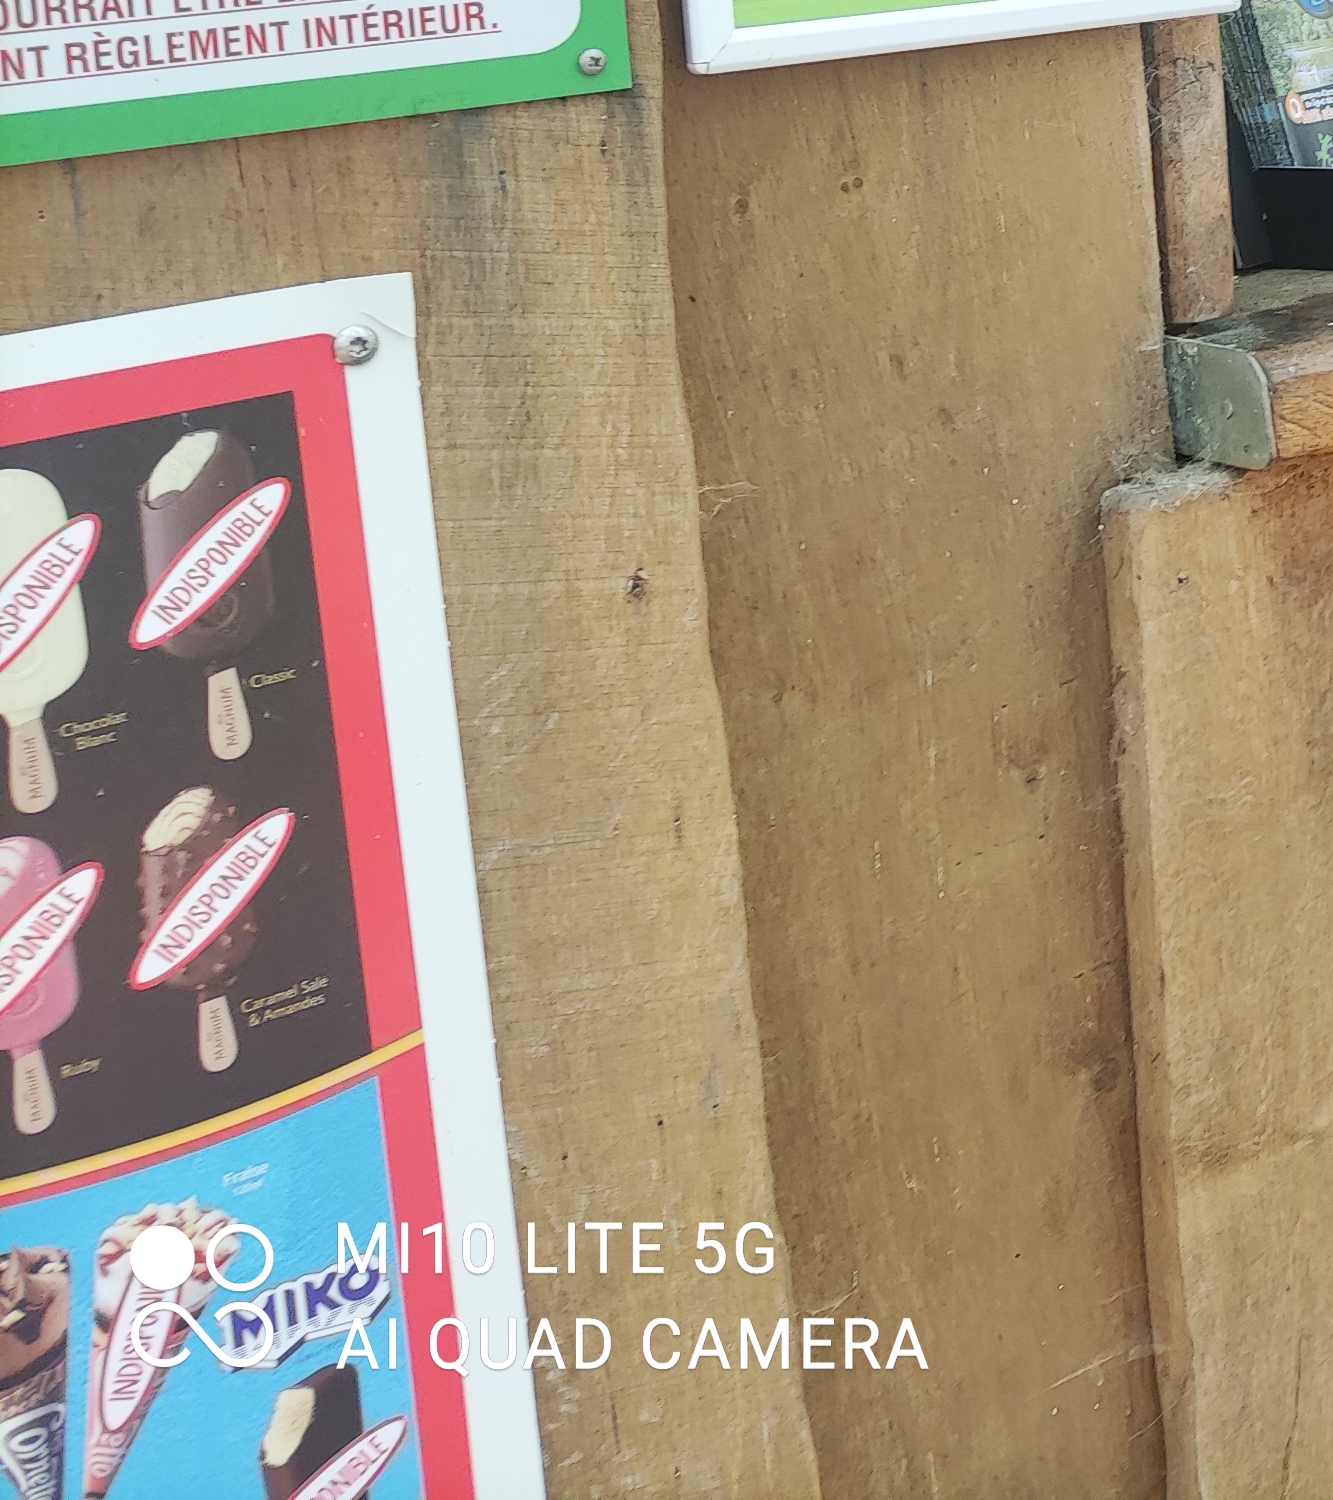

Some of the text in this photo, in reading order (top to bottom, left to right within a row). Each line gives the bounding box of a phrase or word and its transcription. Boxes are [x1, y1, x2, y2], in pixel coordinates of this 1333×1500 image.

[65, 20, 289, 76] RÈGLEMENT
[303, 1, 499, 50] INTÉRIEUR.
[151, 496, 273, 625] INDISPONIBLE
[154, 828, 277, 963] INDISPONIBLE
[232, 1261, 380, 1350] MIKO
